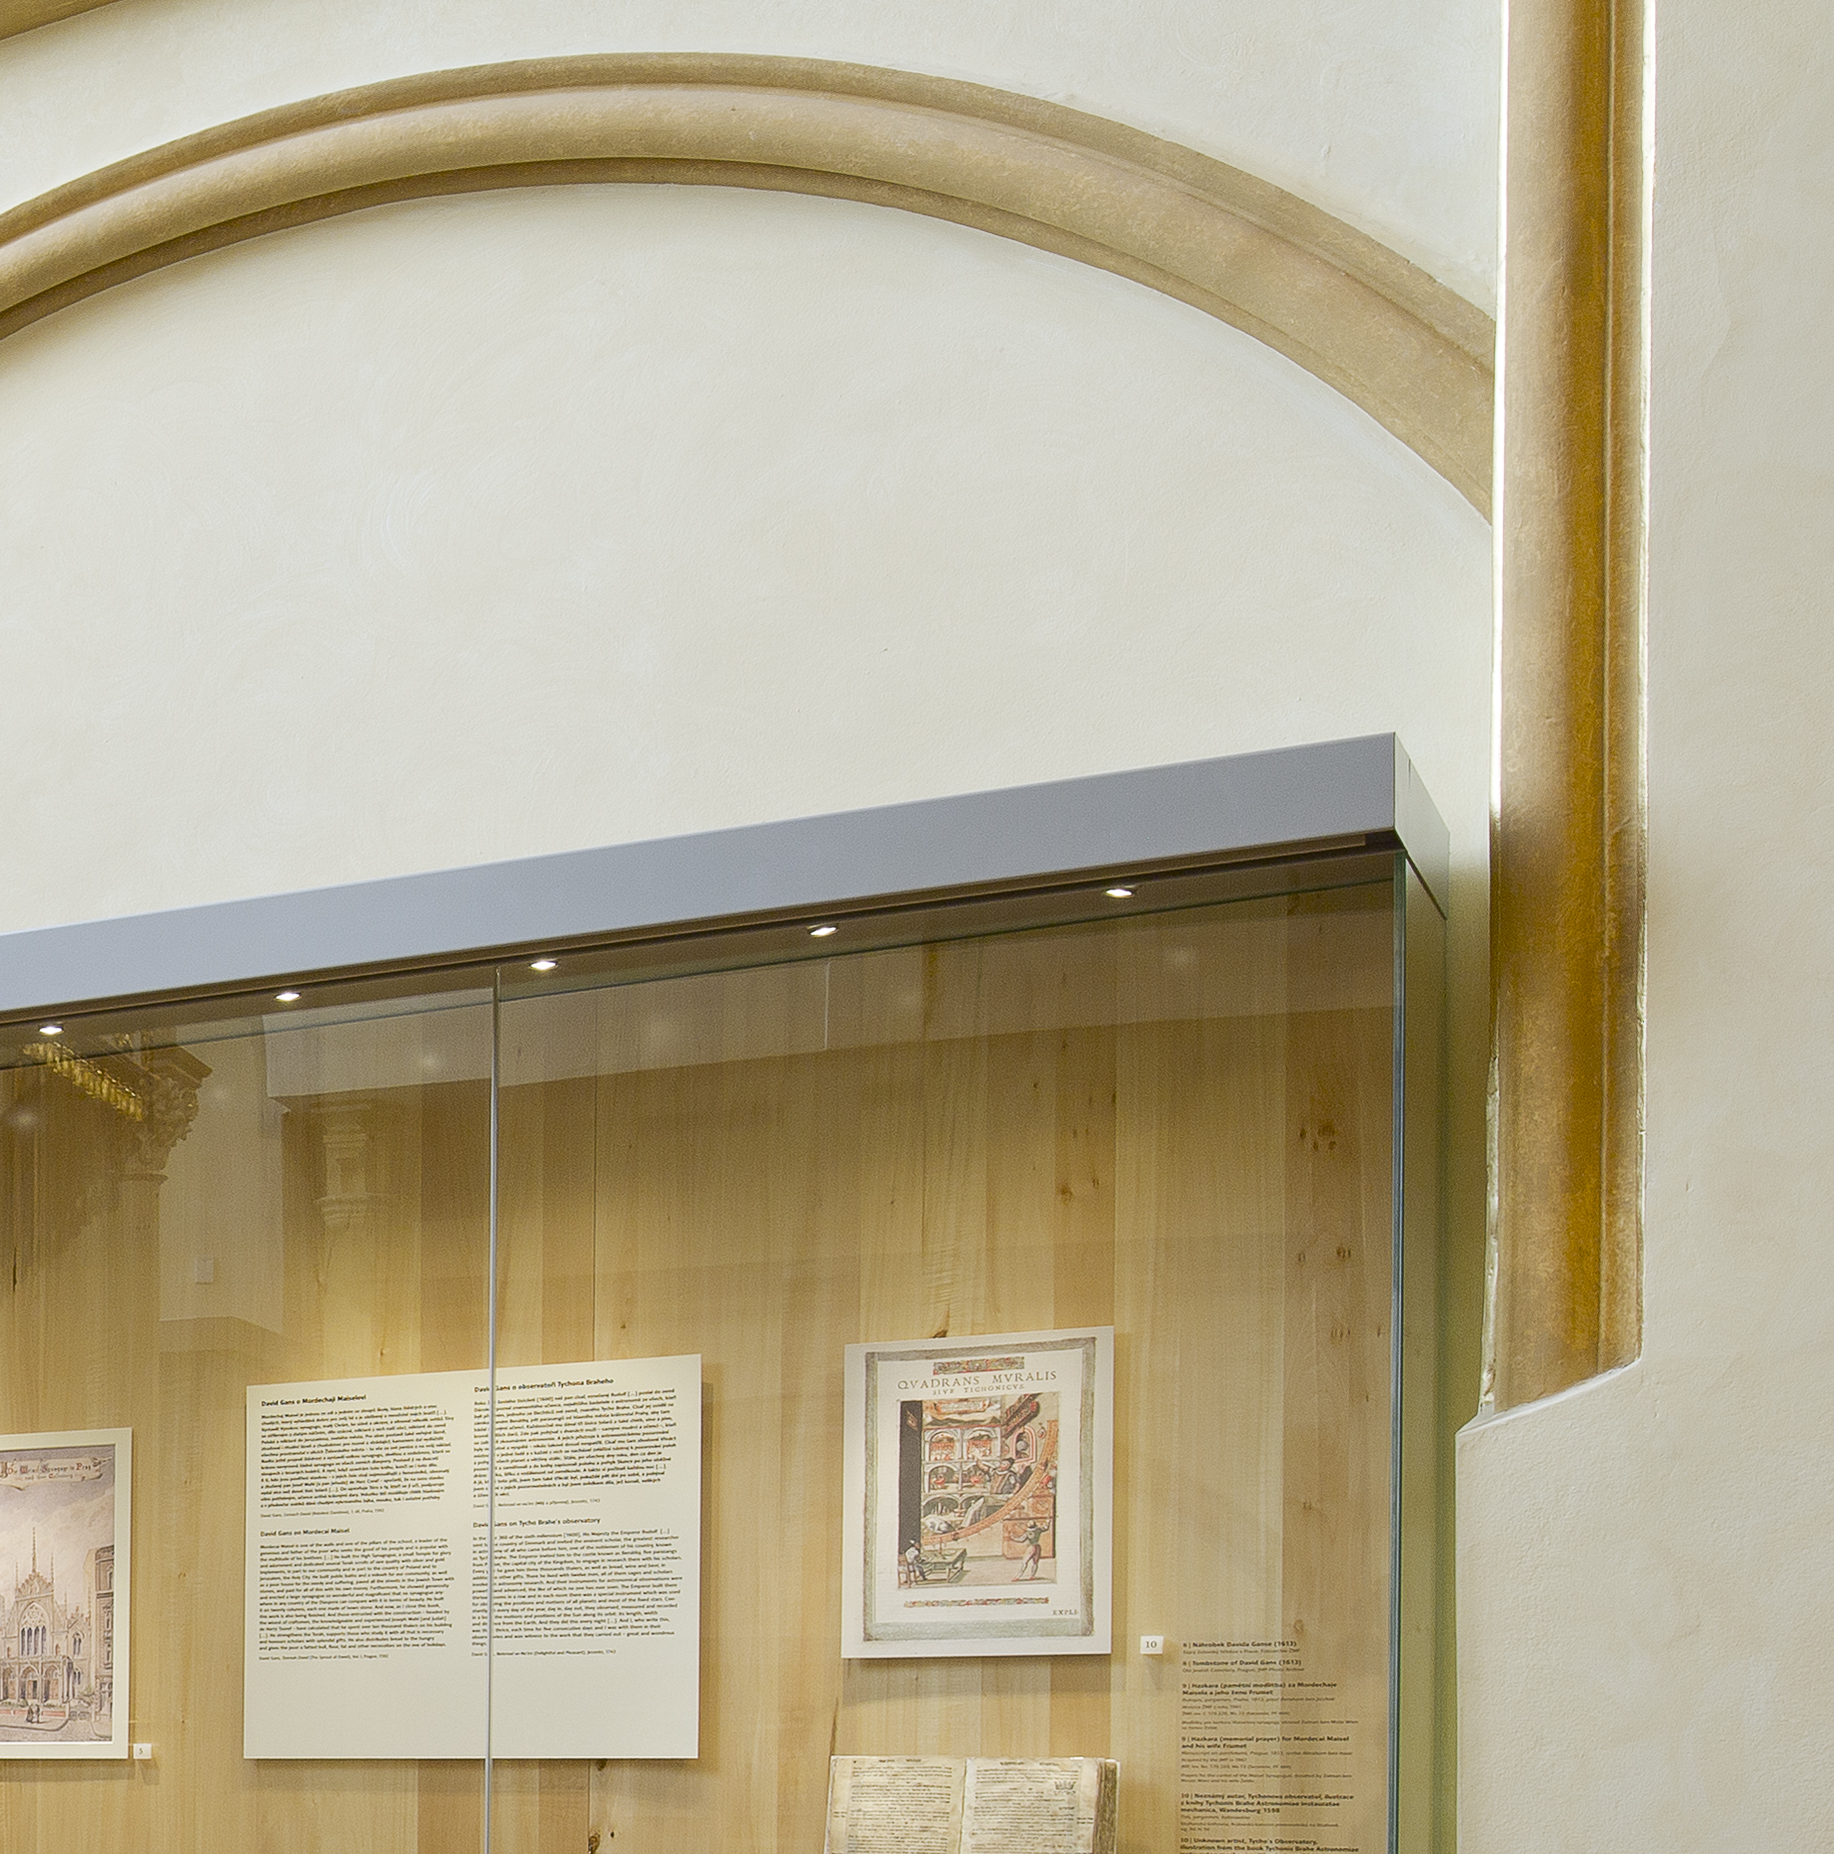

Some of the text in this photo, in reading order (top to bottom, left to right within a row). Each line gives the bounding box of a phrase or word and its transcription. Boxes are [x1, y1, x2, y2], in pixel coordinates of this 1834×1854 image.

[897, 1371, 1057, 1390] QVADRANS MVRALIS
[562, 1517, 601, 1526] observatory
[1144, 1640, 1158, 1648] 10
